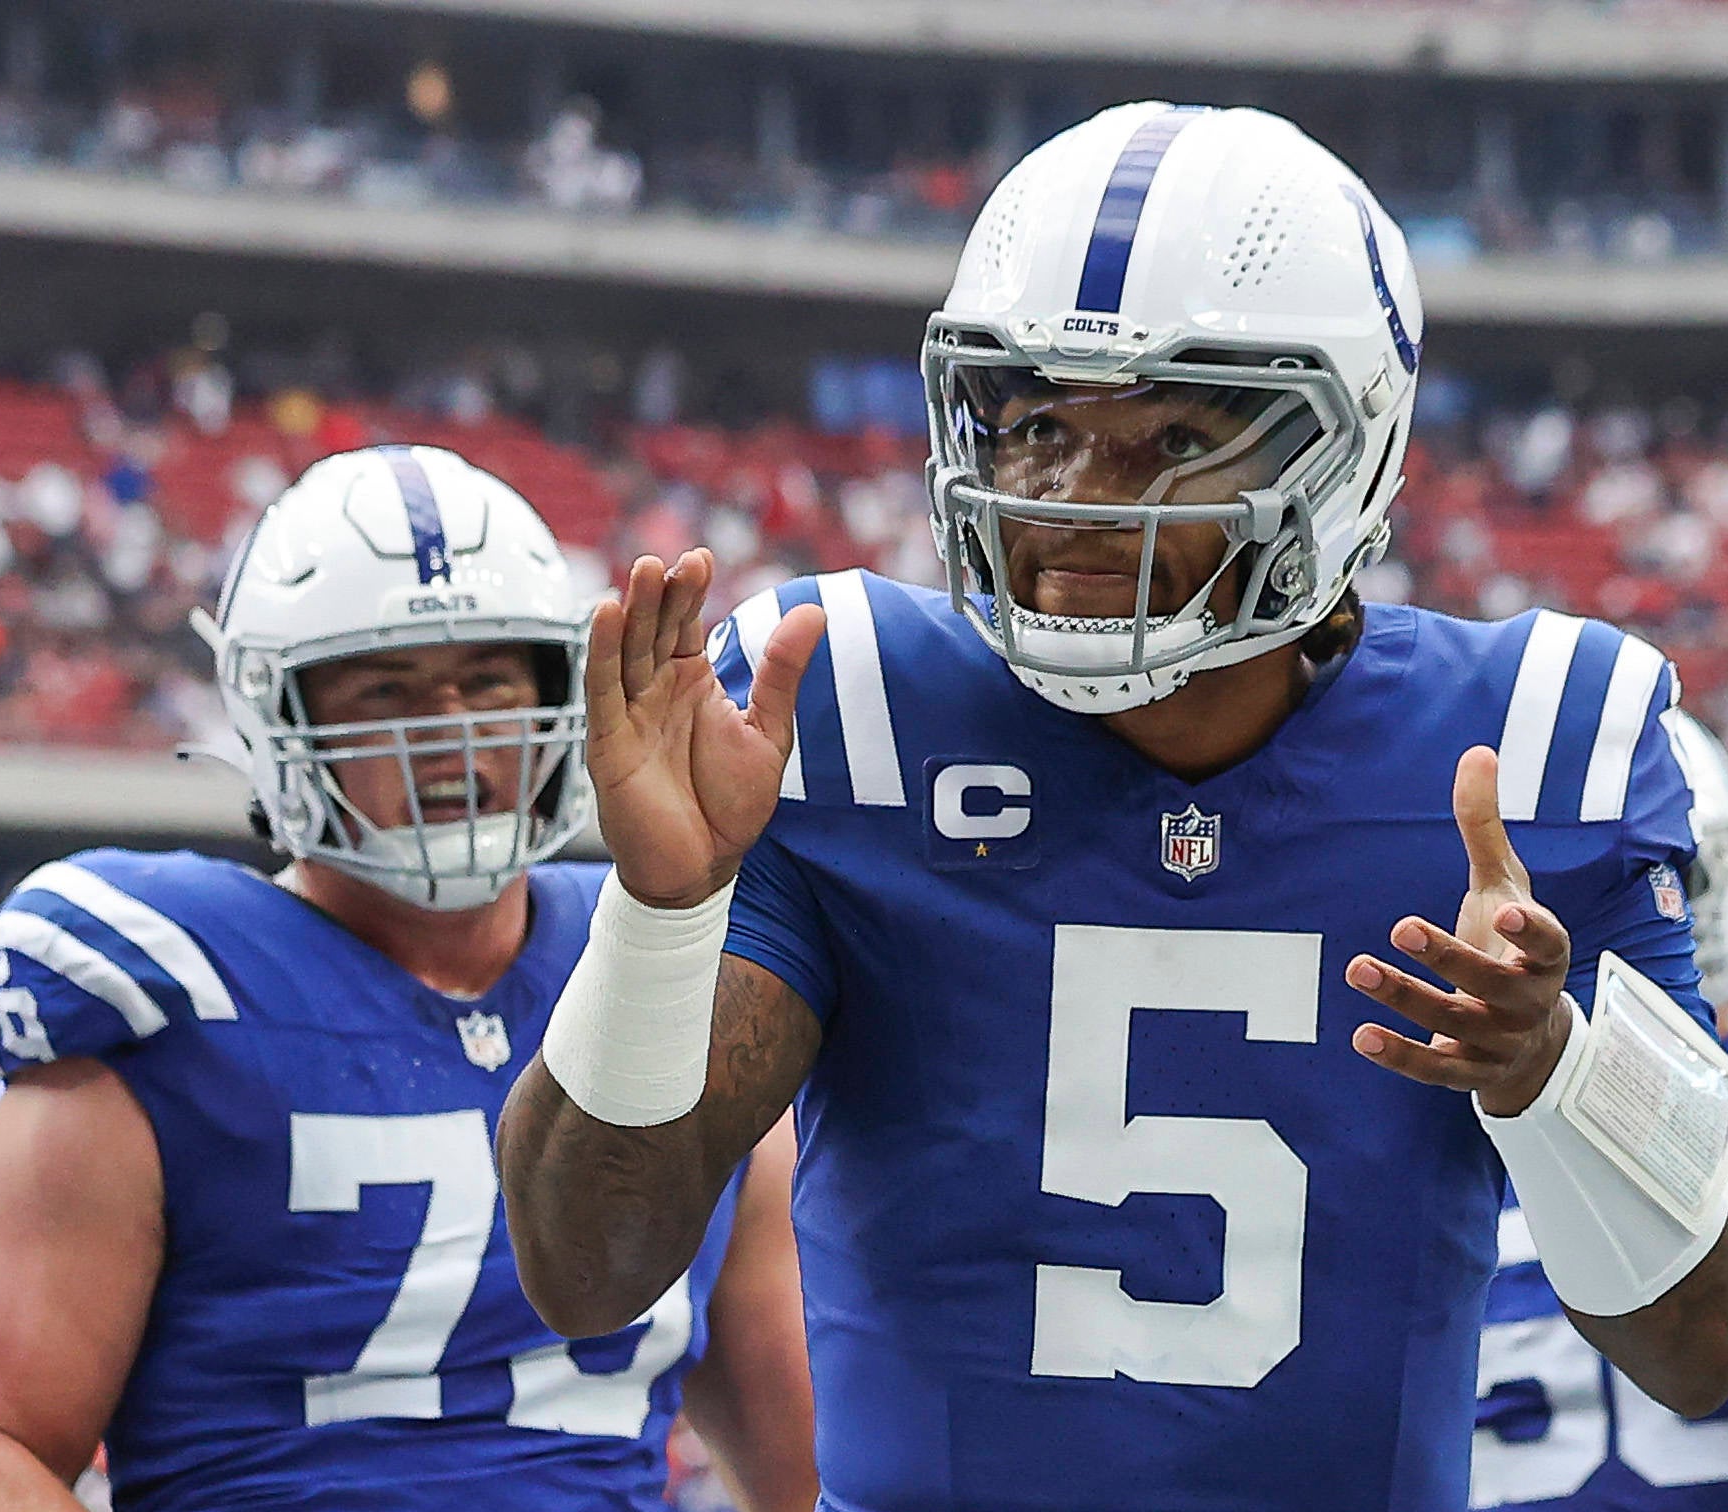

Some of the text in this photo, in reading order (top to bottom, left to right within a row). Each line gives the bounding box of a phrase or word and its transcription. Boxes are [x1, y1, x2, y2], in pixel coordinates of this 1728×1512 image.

[1063, 318, 1119, 336] COLTS
[932, 763, 1032, 840] C
[1171, 838, 1210, 867] NFL
[1030, 923, 1324, 1389] 5
